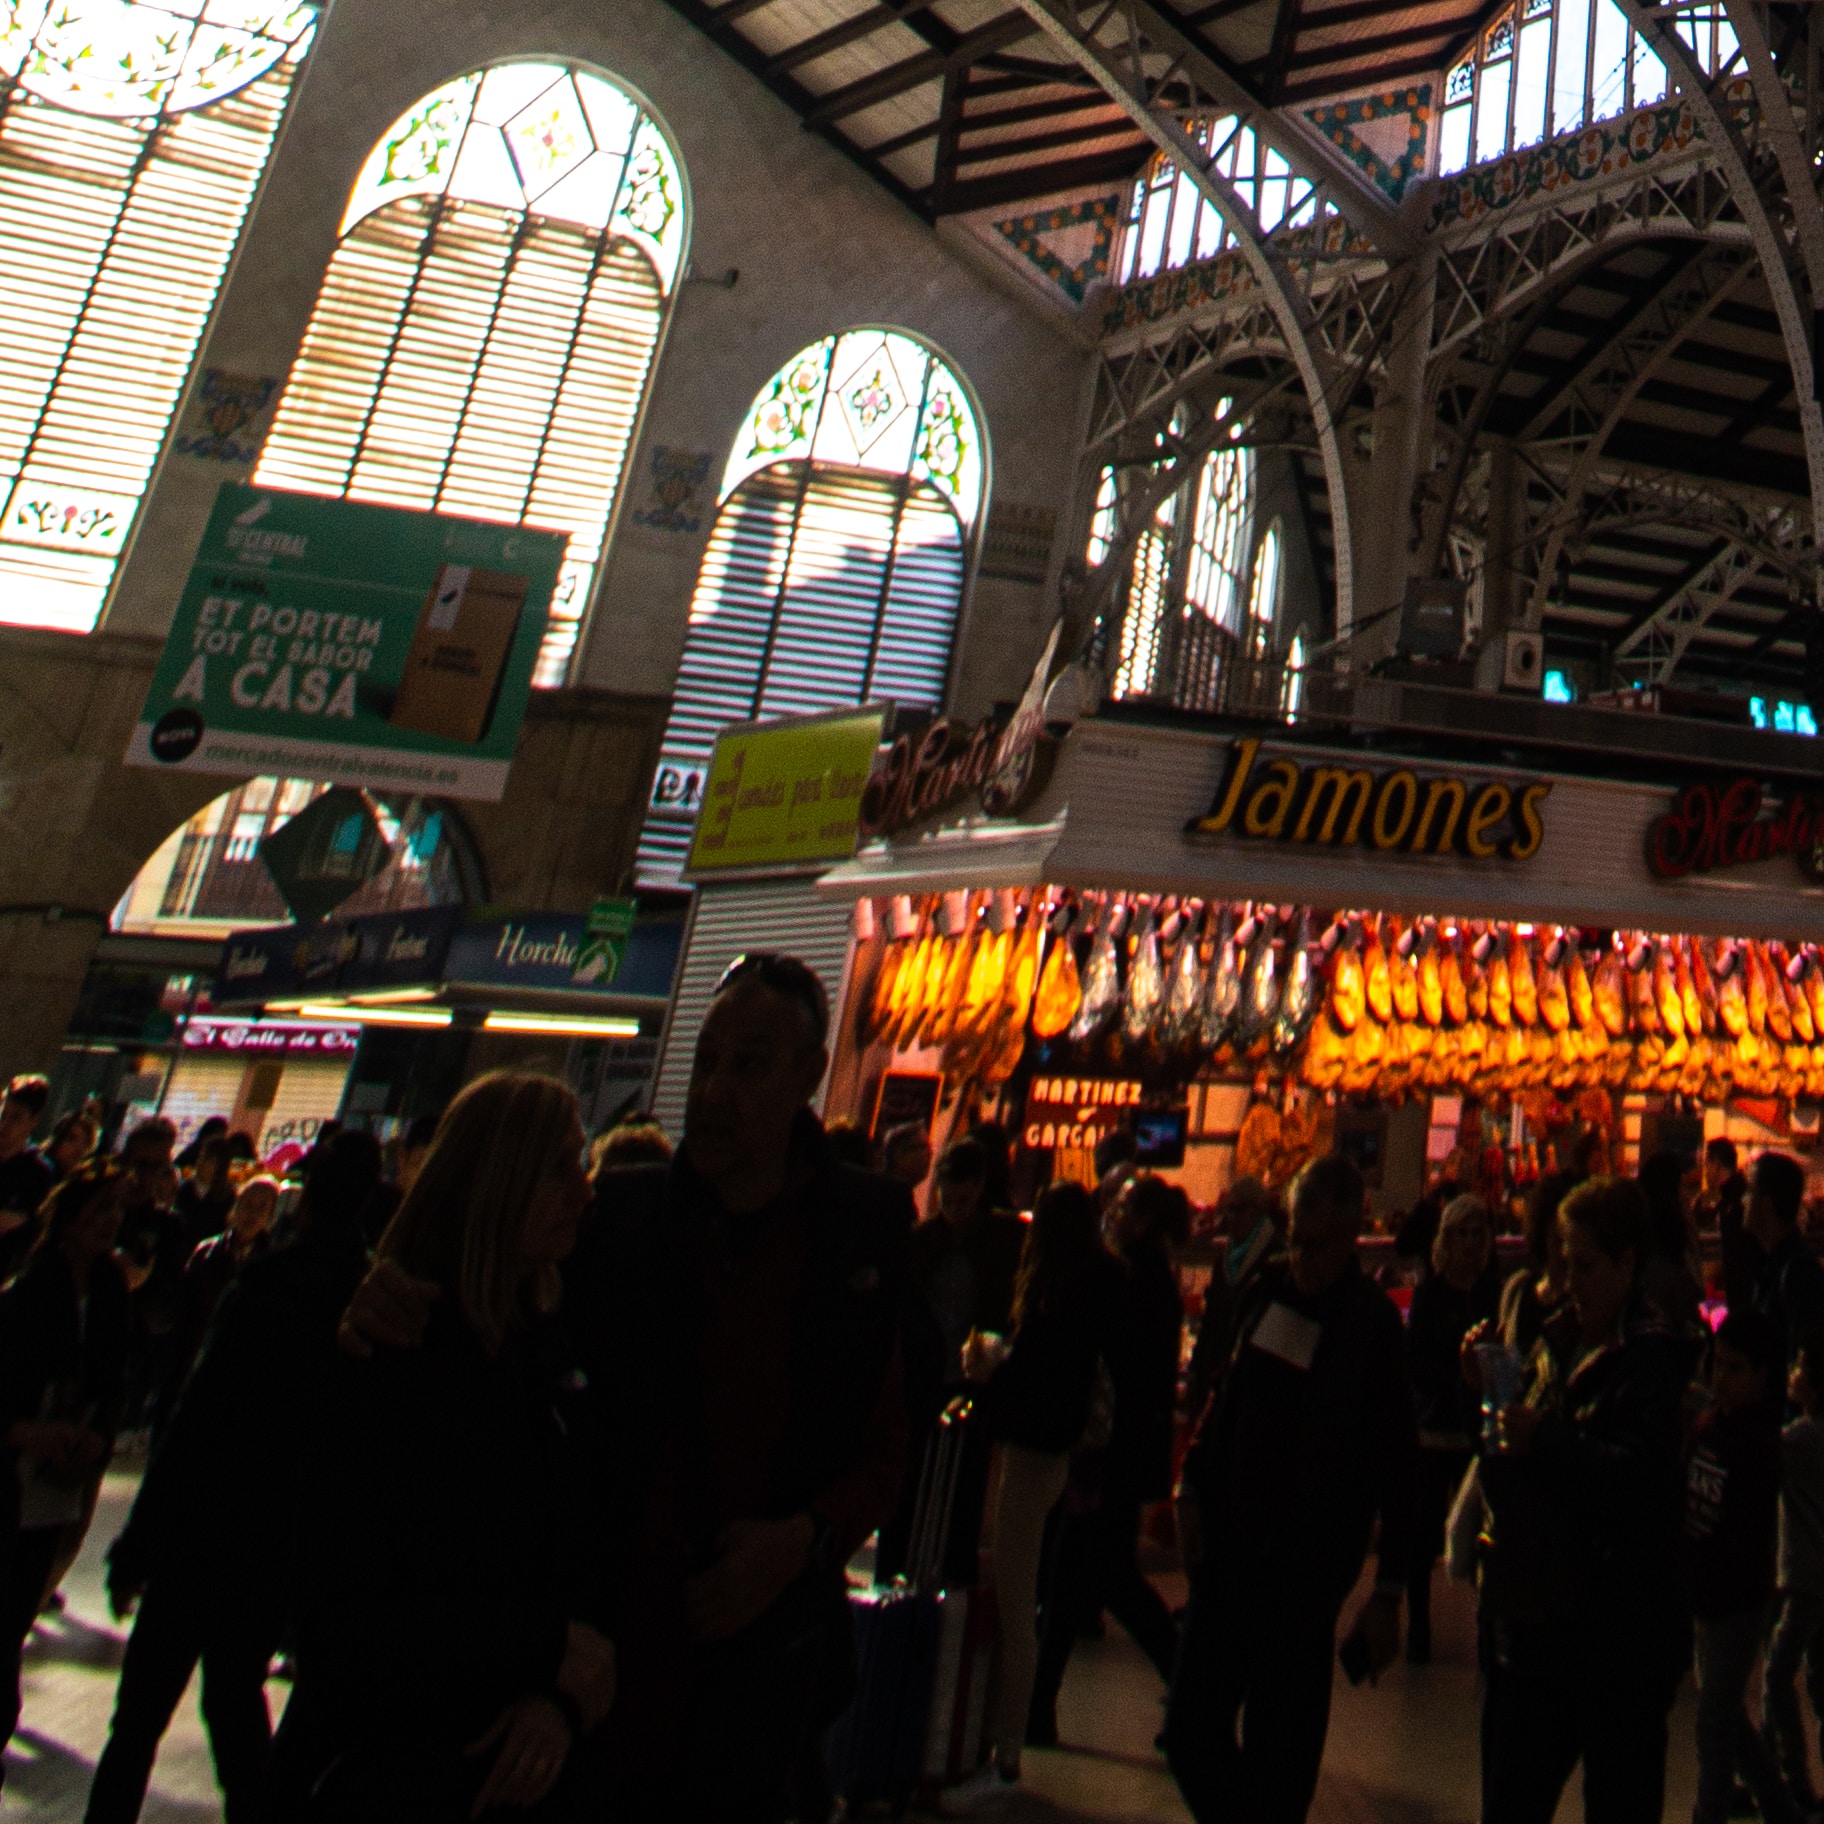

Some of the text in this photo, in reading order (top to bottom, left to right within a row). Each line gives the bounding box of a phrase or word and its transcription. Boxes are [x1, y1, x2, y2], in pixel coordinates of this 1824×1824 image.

[197, 597, 383, 645] ET PORTEM
[192, 627, 374, 672] TOT EL SABOR
[173, 655, 208, 702] A
[230, 661, 358, 720] CASA
[1195, 738, 1555, 861] Jamones
[1032, 1077, 1144, 1106] MARTINEZ
